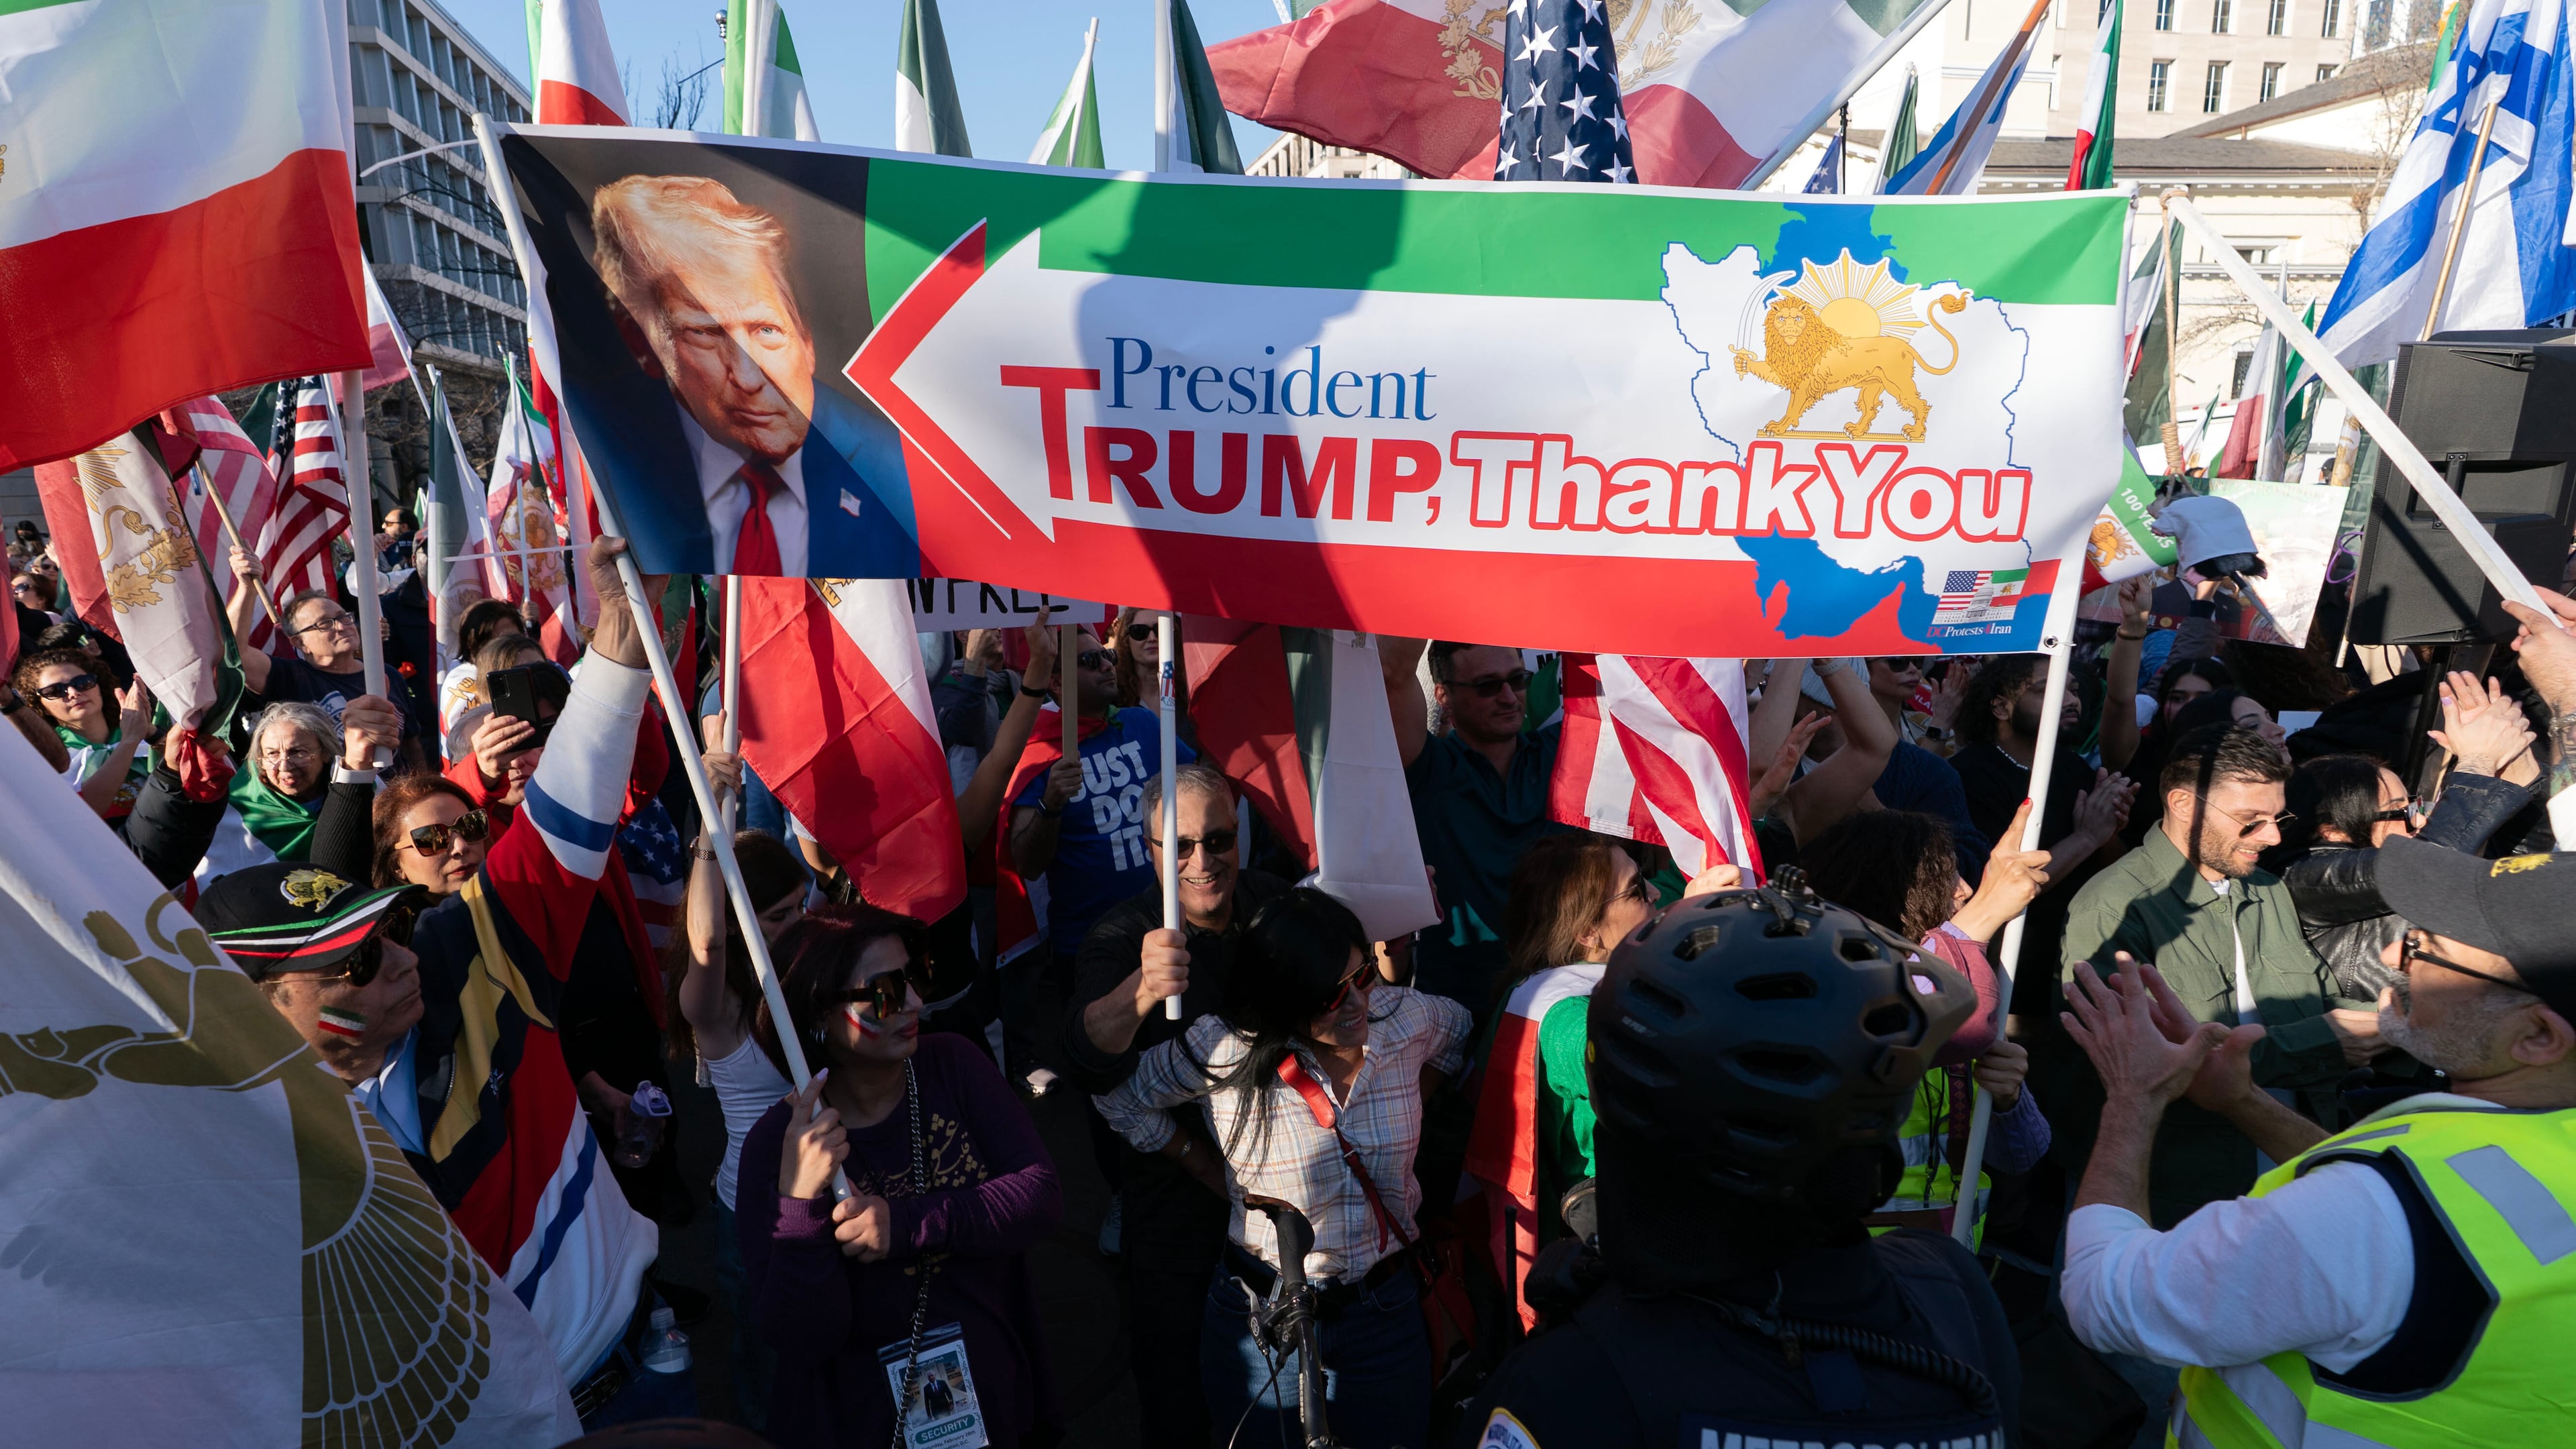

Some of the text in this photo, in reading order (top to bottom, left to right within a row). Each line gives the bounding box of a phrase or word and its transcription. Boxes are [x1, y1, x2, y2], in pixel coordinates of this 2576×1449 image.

[1106, 336, 1438, 421] President
[1000, 364, 1442, 526] TRUMP,
[2120, 487, 2175, 549] 100 YERS
[1069, 740, 1148, 804] JUST
[1090, 784, 1144, 835] DO
[921, 1417, 969, 1442] SECURITY
[944, 1433, 965, 1445] February
